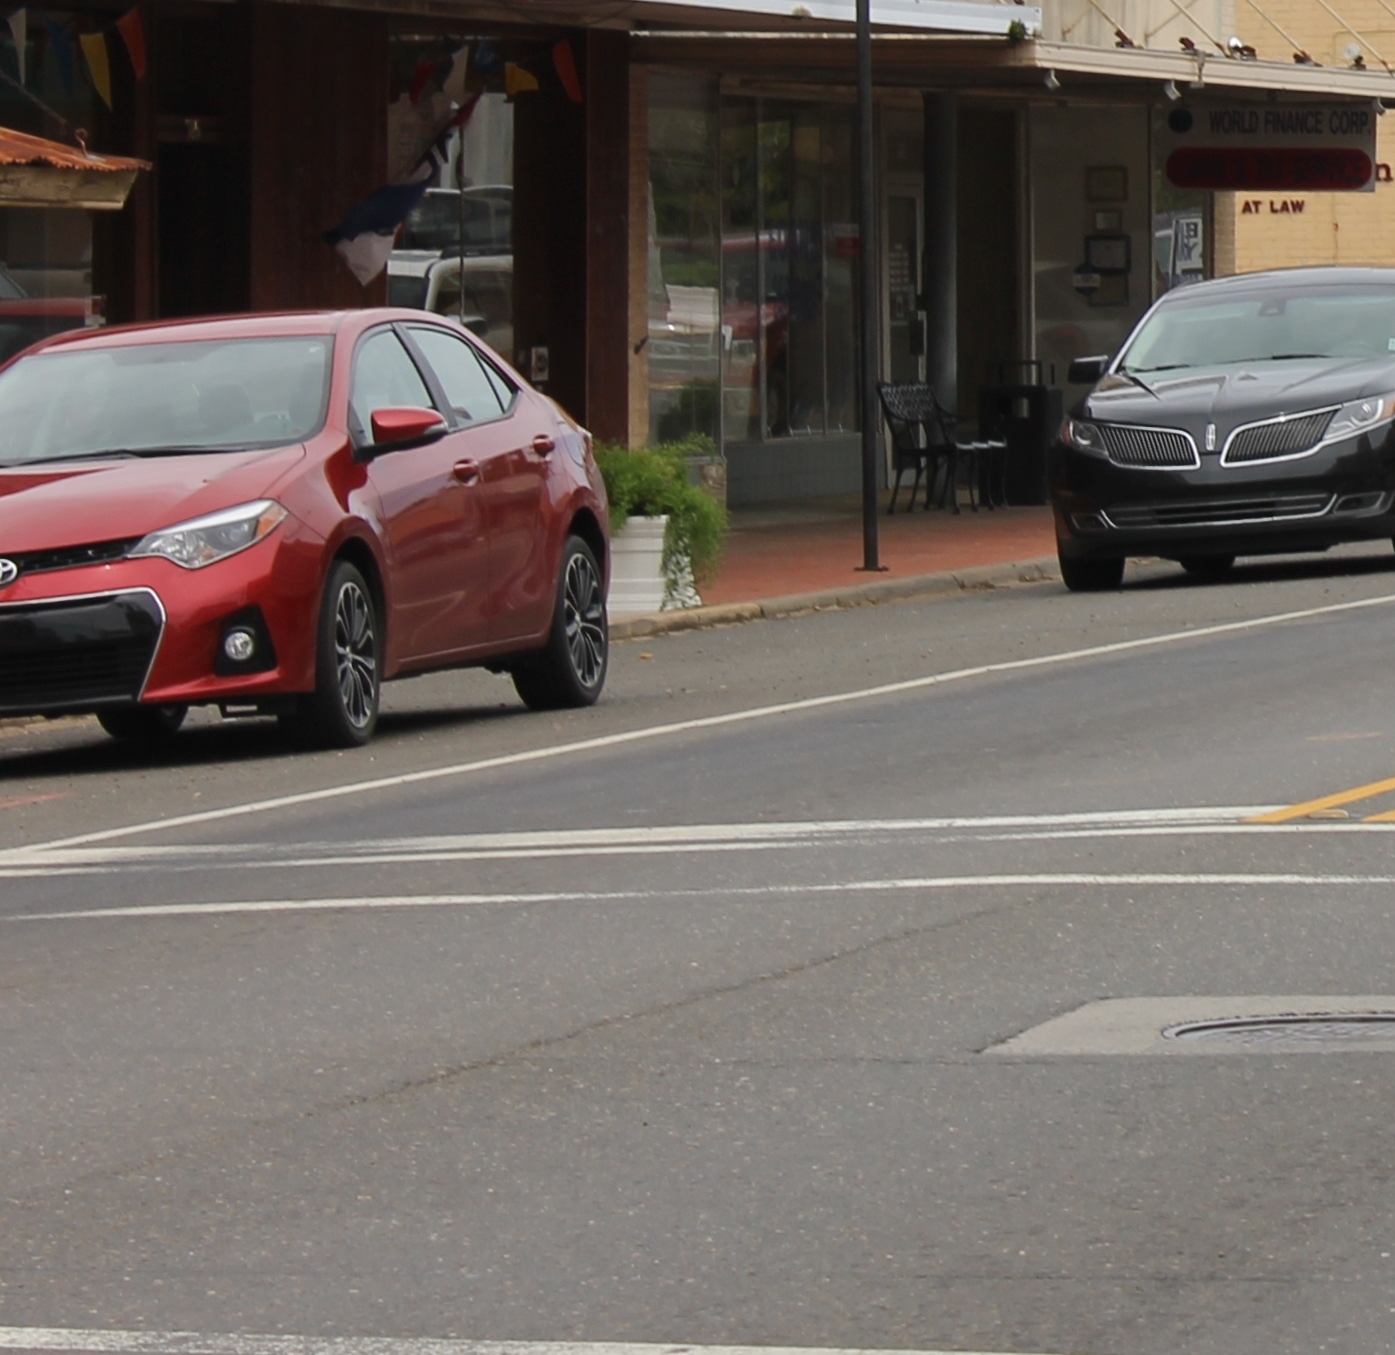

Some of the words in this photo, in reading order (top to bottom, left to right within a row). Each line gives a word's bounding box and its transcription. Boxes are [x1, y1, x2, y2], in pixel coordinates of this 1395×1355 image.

[1208, 110, 1260, 134] WORLD
[1263, 110, 1323, 134] FINANCE
[1328, 110, 1373, 135] CORP.
[1241, 200, 1263, 214] AT
[1269, 200, 1306, 214] LAW
